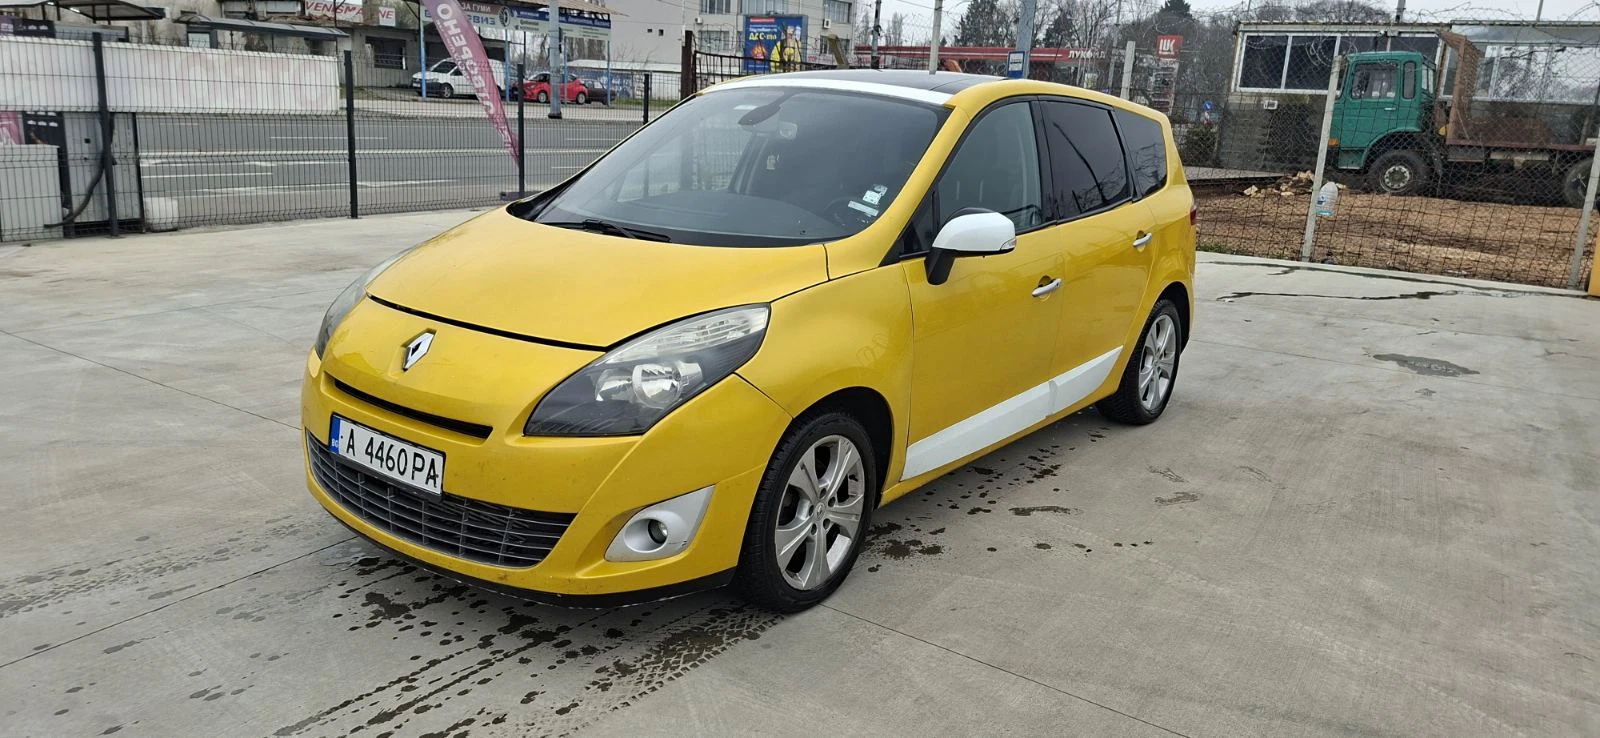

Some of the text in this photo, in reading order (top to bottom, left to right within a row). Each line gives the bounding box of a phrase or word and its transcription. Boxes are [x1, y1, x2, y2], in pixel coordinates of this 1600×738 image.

[331, 438, 339, 448] BG
[346, 428, 356, 457] A
[365, 436, 408, 476] 4460
